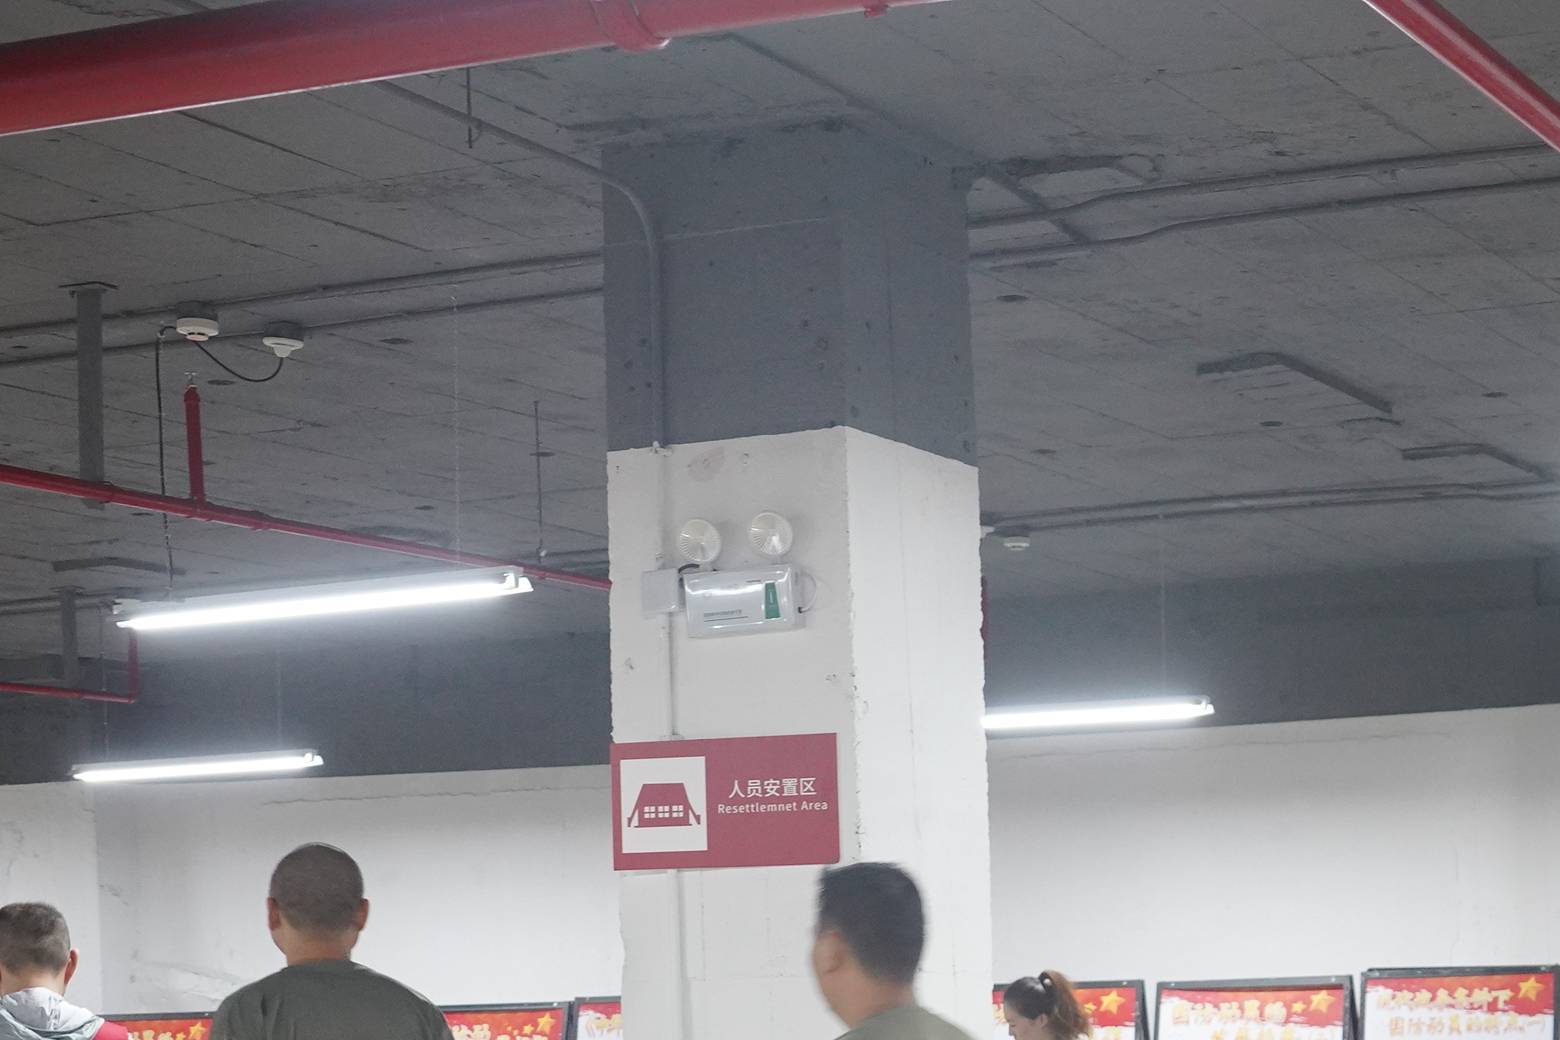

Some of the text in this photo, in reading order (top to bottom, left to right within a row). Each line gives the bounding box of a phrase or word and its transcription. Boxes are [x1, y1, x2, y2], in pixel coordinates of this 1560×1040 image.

[728, 777, 817, 799] 人员安置区
[717, 801, 829, 814] Resettlemnet Area
